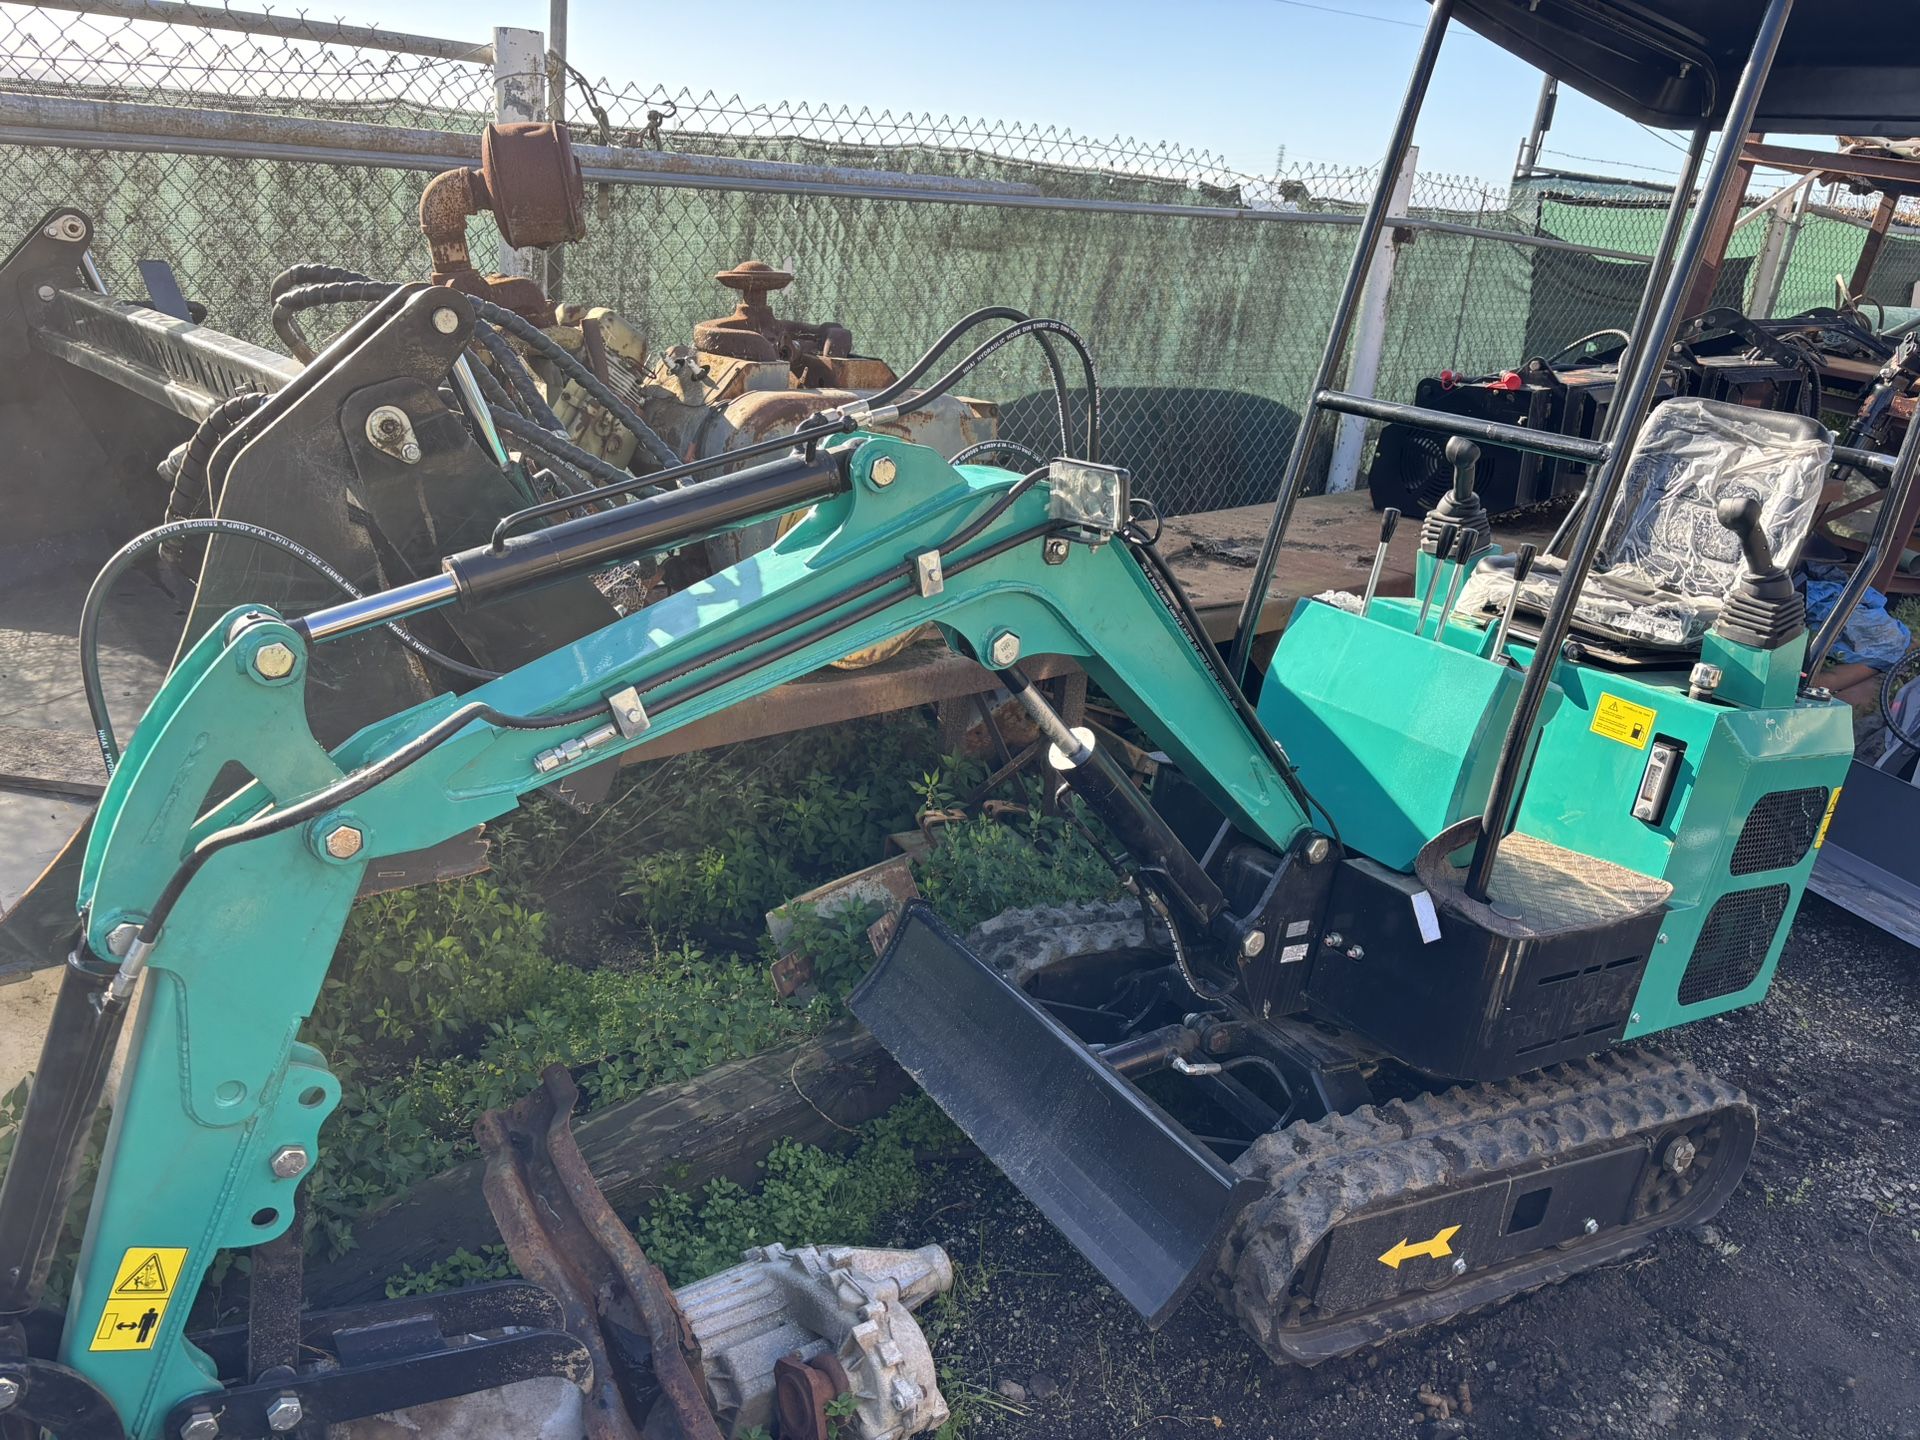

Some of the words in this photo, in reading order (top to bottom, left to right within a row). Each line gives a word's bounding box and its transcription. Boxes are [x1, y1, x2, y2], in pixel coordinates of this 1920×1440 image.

[977, 337, 1006, 362] HYDRAULIC
[1006, 328, 1021, 340] HOSE
[156, 525, 181, 537] MADE
[144, 535, 153, 543] IN
[124, 541, 142, 555] PRC
[306, 553, 321, 566] 2SC
[344, 581, 356, 594] DIN
[386, 621, 410, 641] HYDRA
